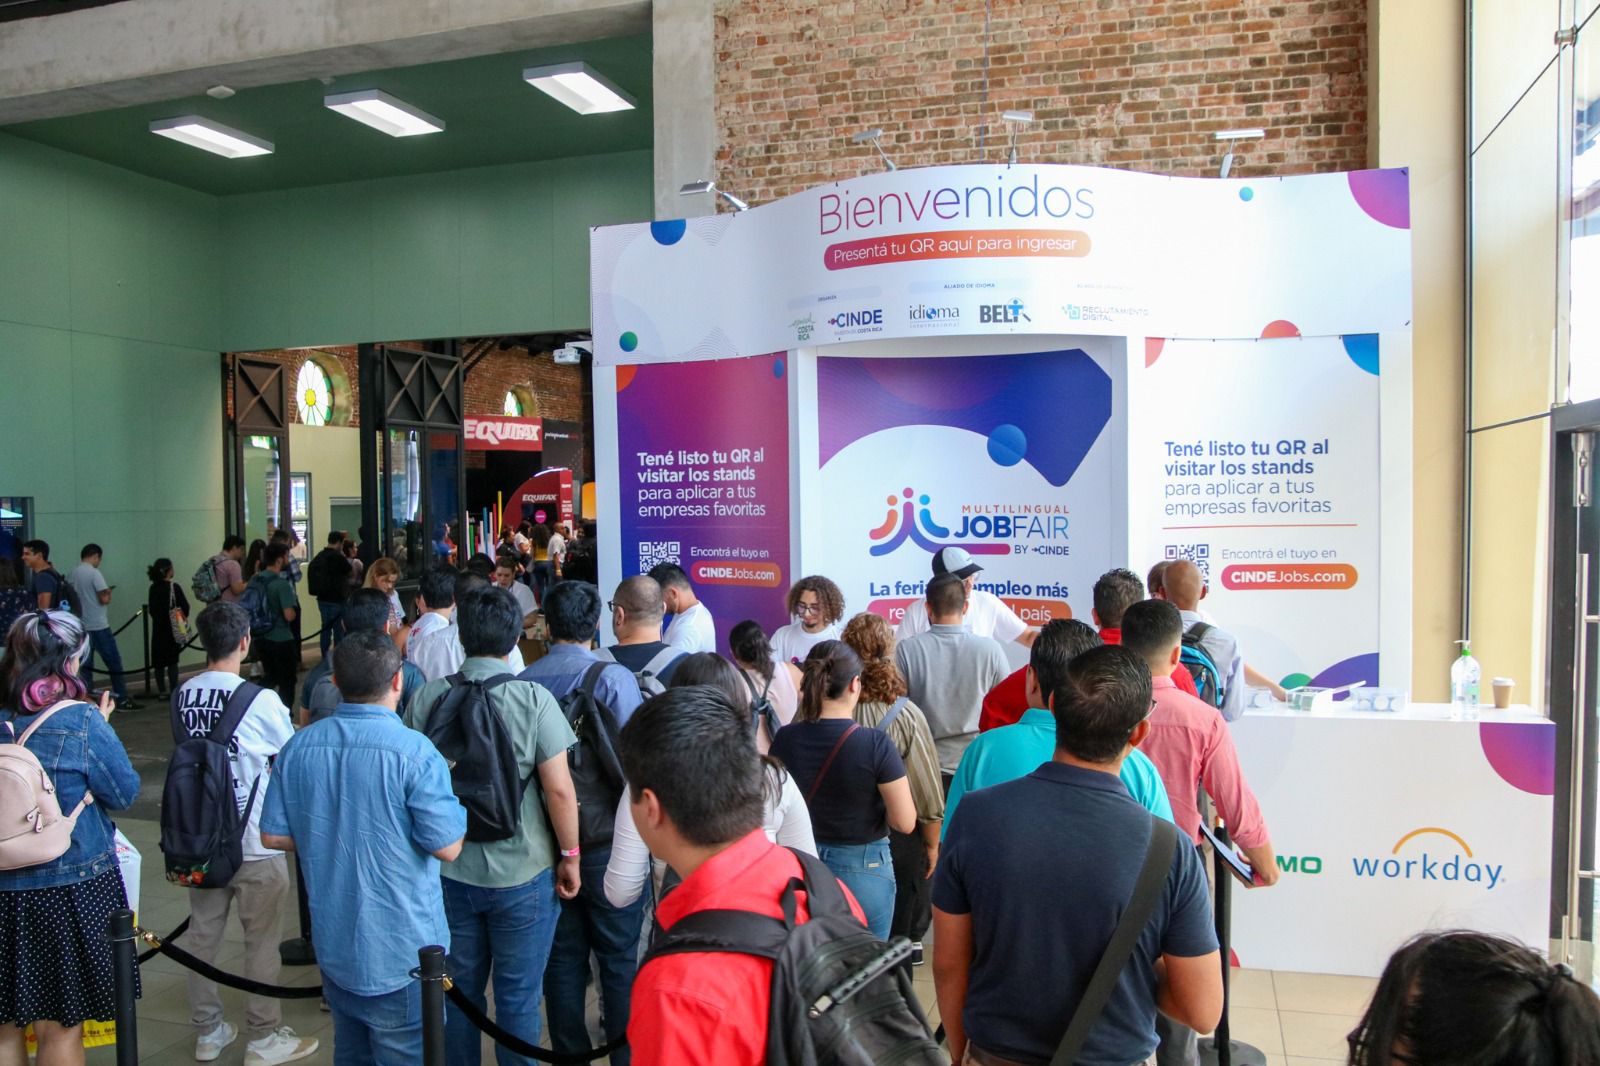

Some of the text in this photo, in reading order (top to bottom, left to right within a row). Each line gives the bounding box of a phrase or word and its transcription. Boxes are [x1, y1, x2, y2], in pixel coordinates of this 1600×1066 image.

[820, 174, 1094, 236] Bienvenidos
[834, 234, 1077, 264] Presentá tu QR aquí para ingresar
[836, 309, 883, 328] CINDE
[909, 304, 960, 320] idioma
[464, 419, 541, 445] EQUIFAX
[637, 447, 764, 466] Tené listo tu QR al
[1164, 439, 1329, 457] Tené listo tu QR al
[637, 466, 755, 483] visitar los stands
[1164, 459, 1314, 476] visitar los stands
[638, 485, 756, 503] para aplicar a tus
[1165, 479, 1315, 498] para aplicar a tus
[522, 494, 557, 503] EQUIFAX
[1165, 497, 1332, 517] empresas favoritas
[638, 501, 766, 519] empresas favoritas
[962, 505, 1070, 514] MULTILINGUAL
[954, 515, 1070, 540] JOBFAIR
[690, 546, 769, 559] Encontrá el tuyo en
[1014, 545, 1070, 556] BY CINDE
[1221, 548, 1337, 561] Encontrá el tuyo en
[699, 567, 775, 581] CINDEJobs.com
[1231, 571, 1346, 583] CINDEJobs.com
[870, 582, 890, 596] La
[1036, 582, 1069, 598] más
[1020, 605, 1052, 621] país
[1275, 855, 1322, 874] MO
[1353, 853, 1503, 890] workday
